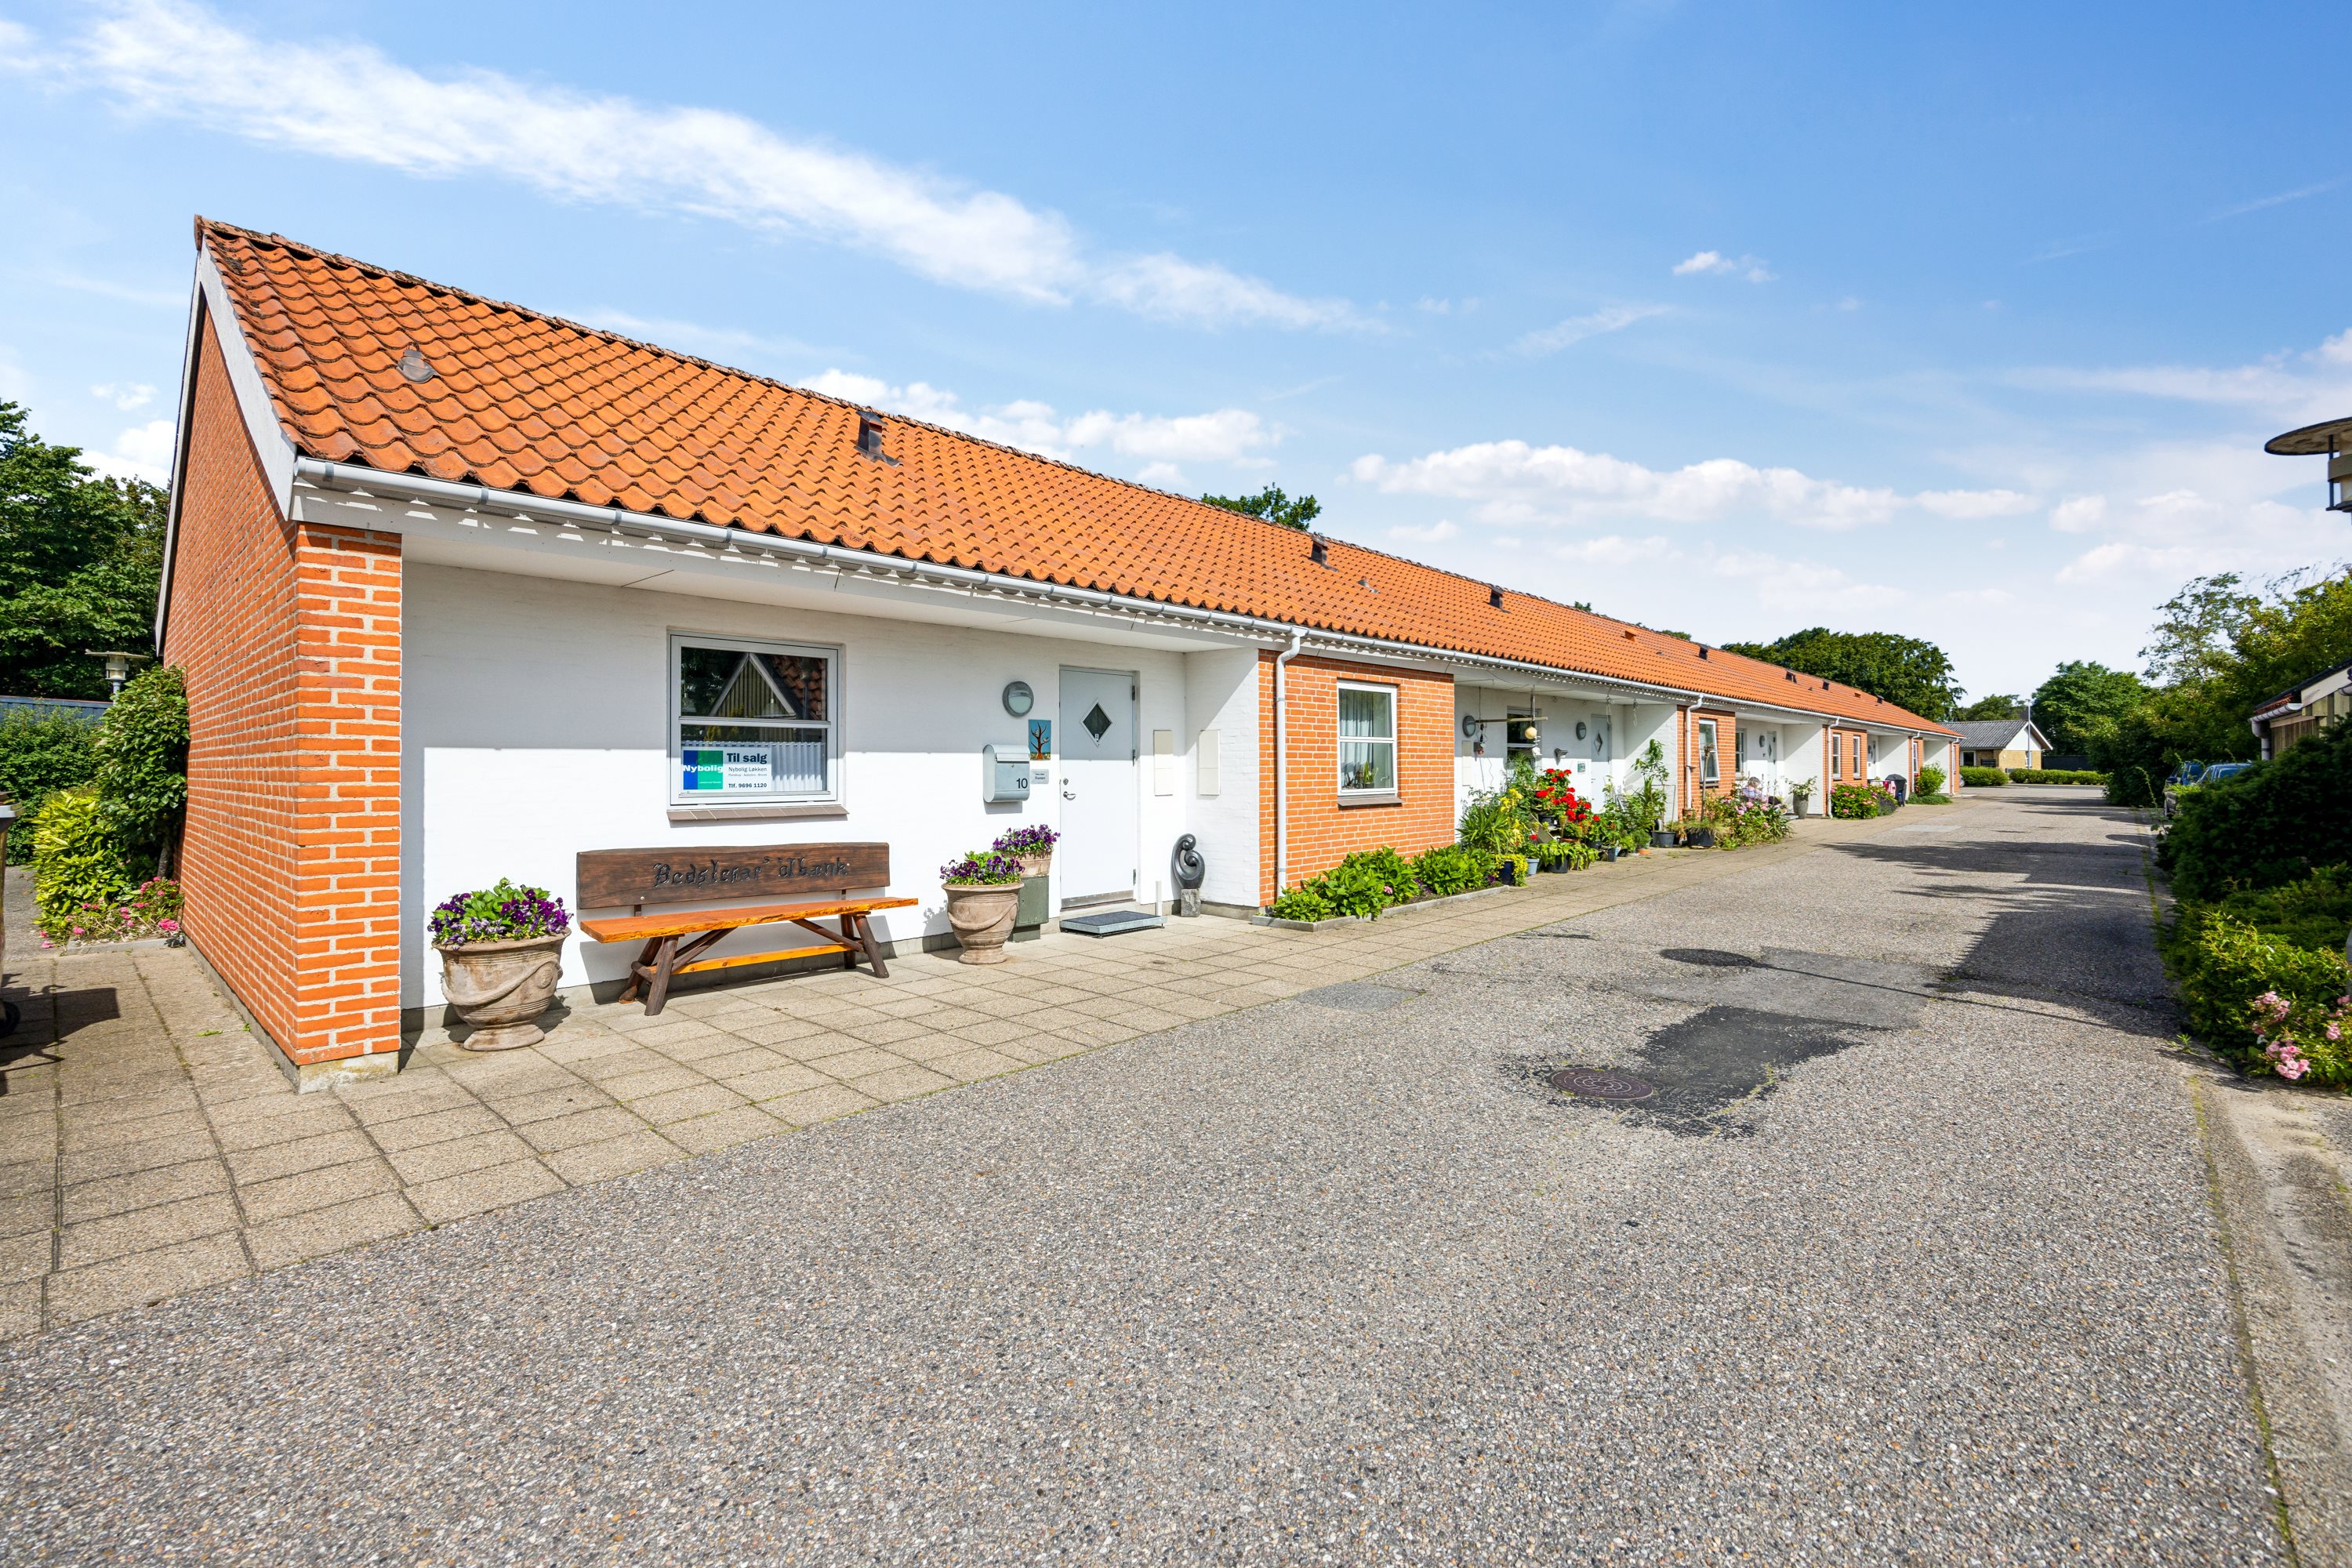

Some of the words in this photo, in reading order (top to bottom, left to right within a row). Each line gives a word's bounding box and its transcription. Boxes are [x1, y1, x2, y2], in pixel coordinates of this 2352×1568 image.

[727, 753, 740, 763] Til
[742, 753, 768, 764] salg
[1016, 778, 1028, 789] 10
